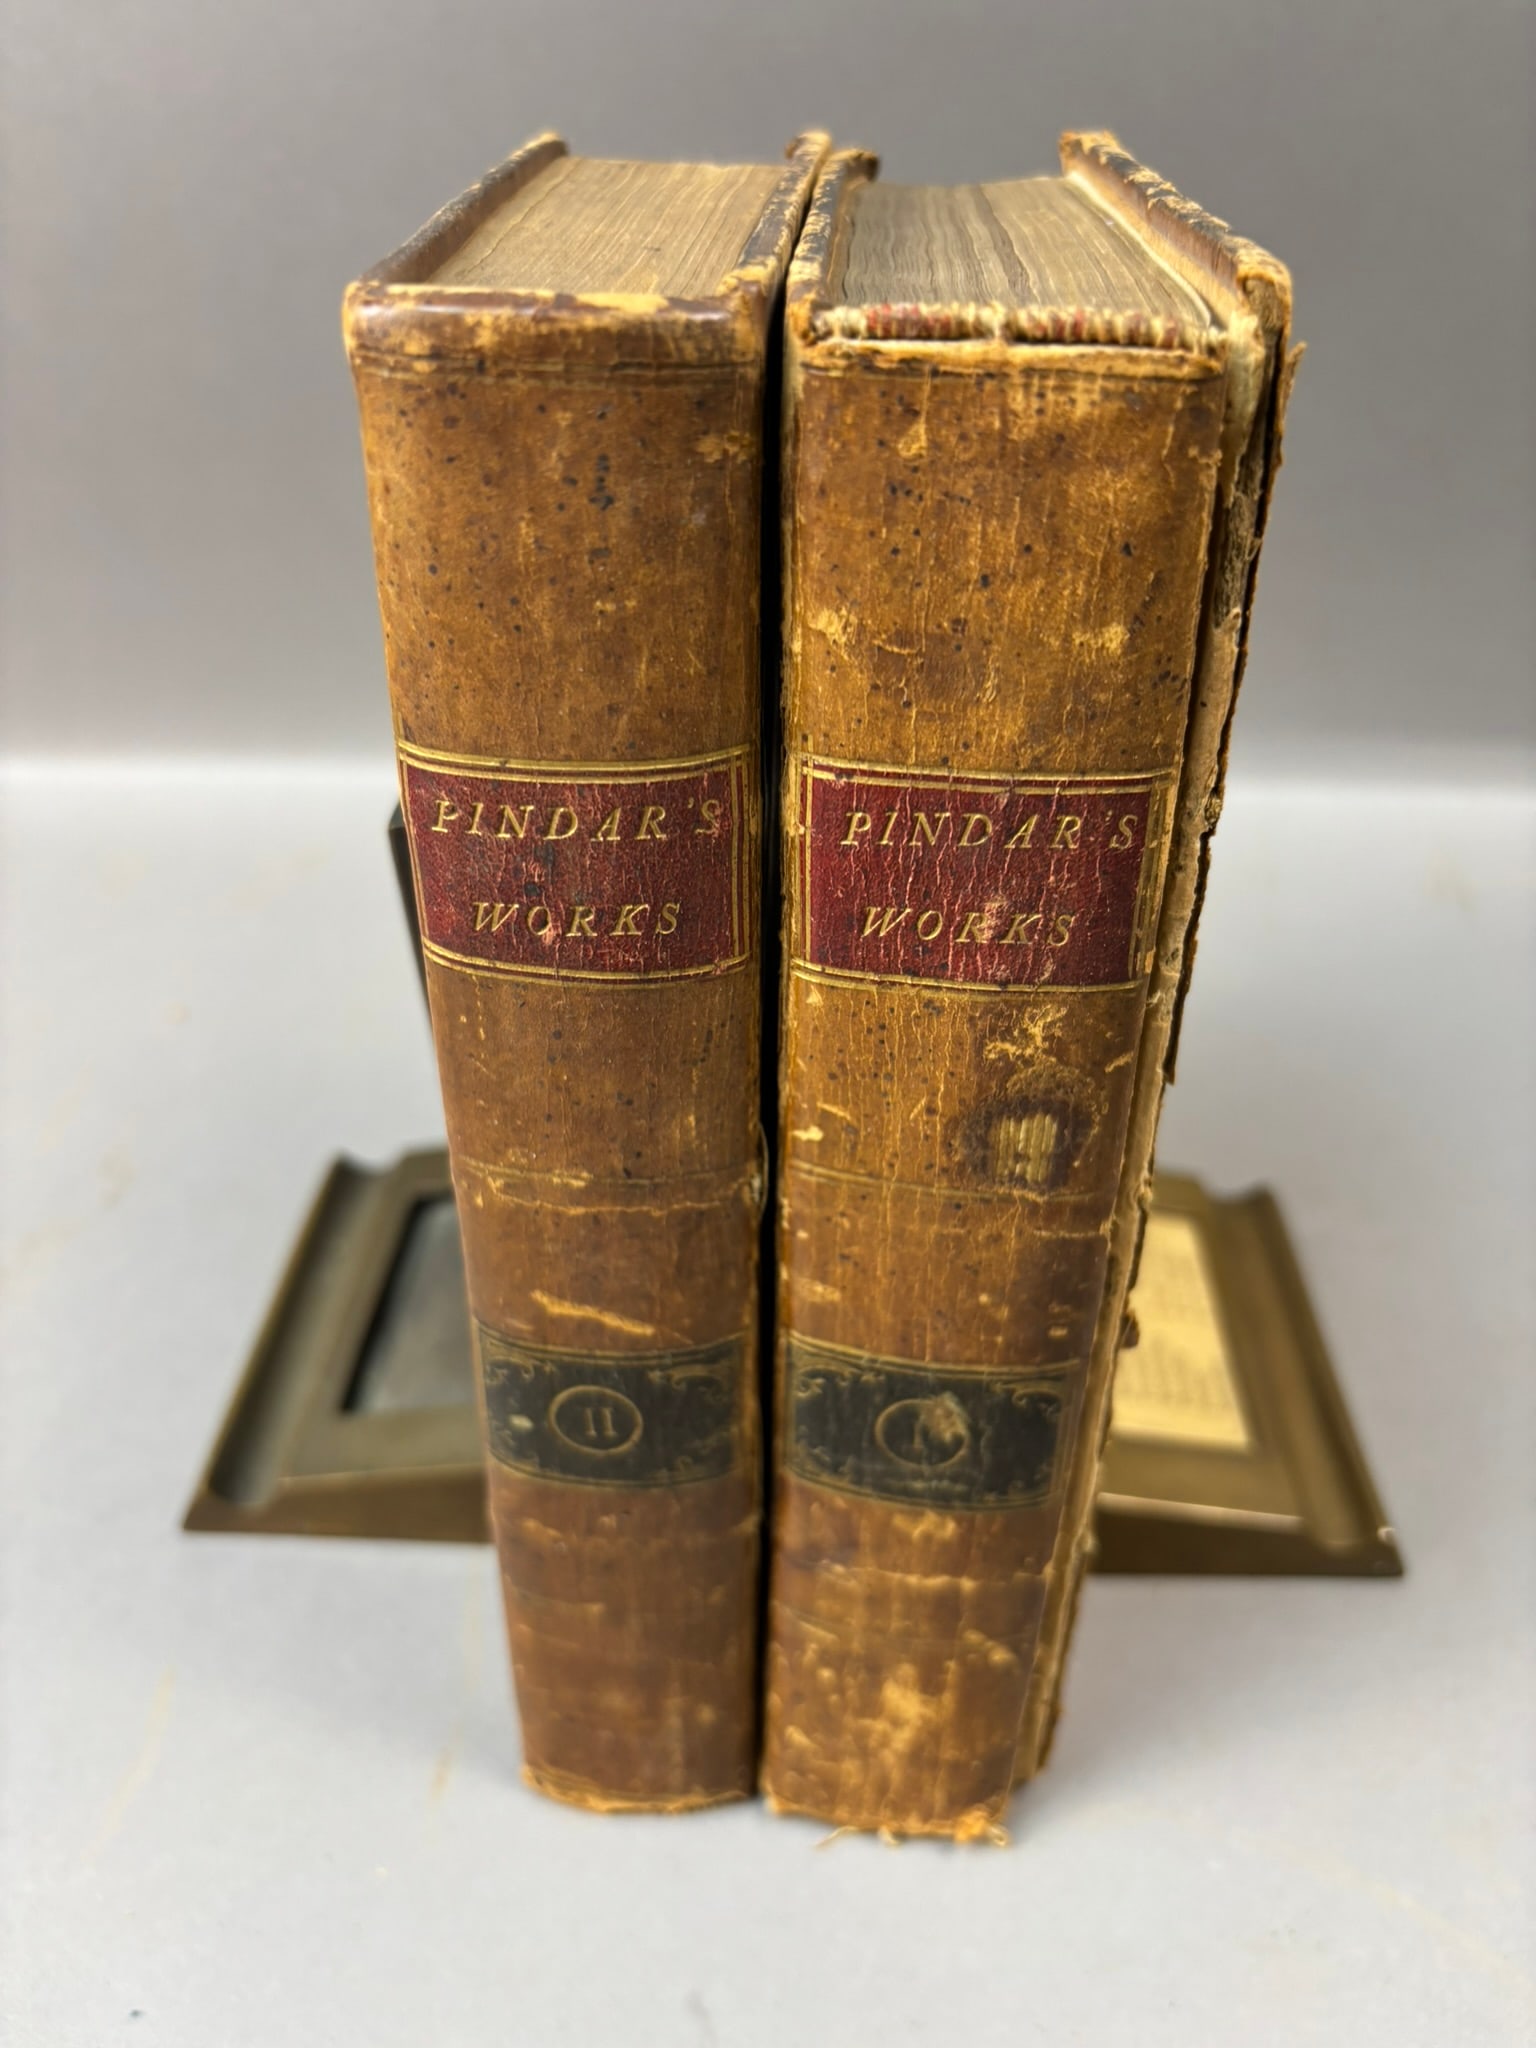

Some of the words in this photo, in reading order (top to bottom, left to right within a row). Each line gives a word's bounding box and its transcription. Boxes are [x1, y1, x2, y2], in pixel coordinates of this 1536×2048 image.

[431, 799, 722, 842] PINDAR'S
[840, 811, 1139, 850] PINDAR'S
[472, 901, 682, 938] WORKS
[861, 905, 1077, 947] WORKS
